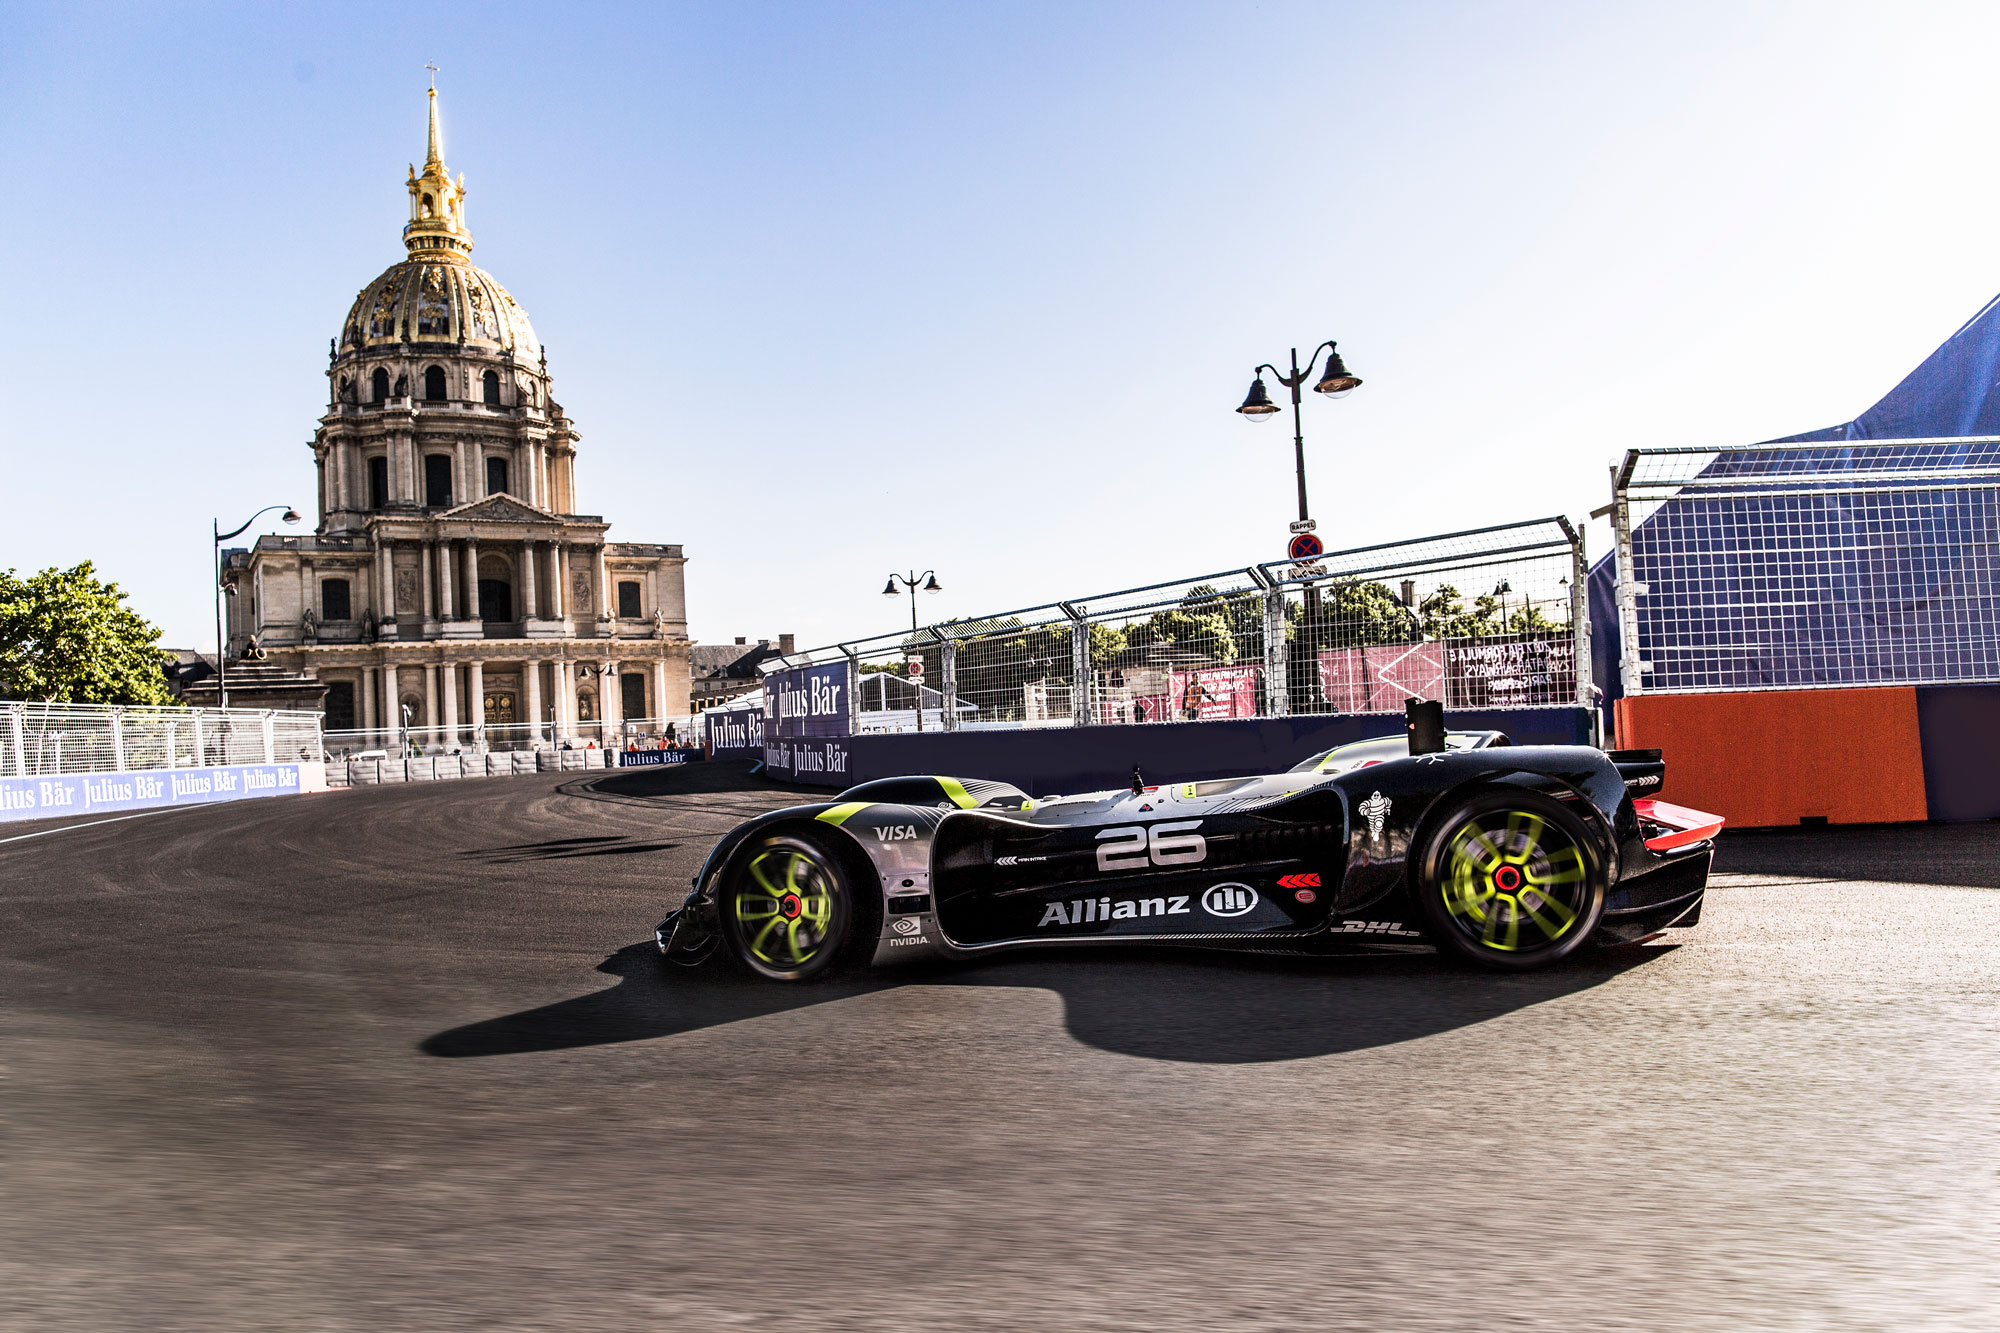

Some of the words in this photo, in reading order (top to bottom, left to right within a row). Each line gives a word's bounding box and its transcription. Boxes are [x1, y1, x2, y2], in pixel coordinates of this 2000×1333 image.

[1291, 522, 1314, 530] RAPPEL
[810, 675, 840, 716] Bär
[710, 716, 746, 757] Julius
[624, 753, 660, 767] Julius
[663, 751, 686, 764] Bär
[794, 743, 824, 777] Julius
[826, 743, 848, 772] Bär
[0, 784, 36, 811] lius
[39, 781, 75, 807] Bär
[83, 778, 133, 809] Julius
[135, 776, 164, 800] Bär
[171, 772, 212, 801] Julius
[213, 770, 238, 793] Bär
[242, 768, 277, 794] Julius
[277, 767, 298, 788] Bär
[872, 825, 917, 841] VISA
[1094, 819, 1207, 872] 26
[1037, 895, 1190, 927] Allianz
[1341, 920, 1409, 936] DHL
